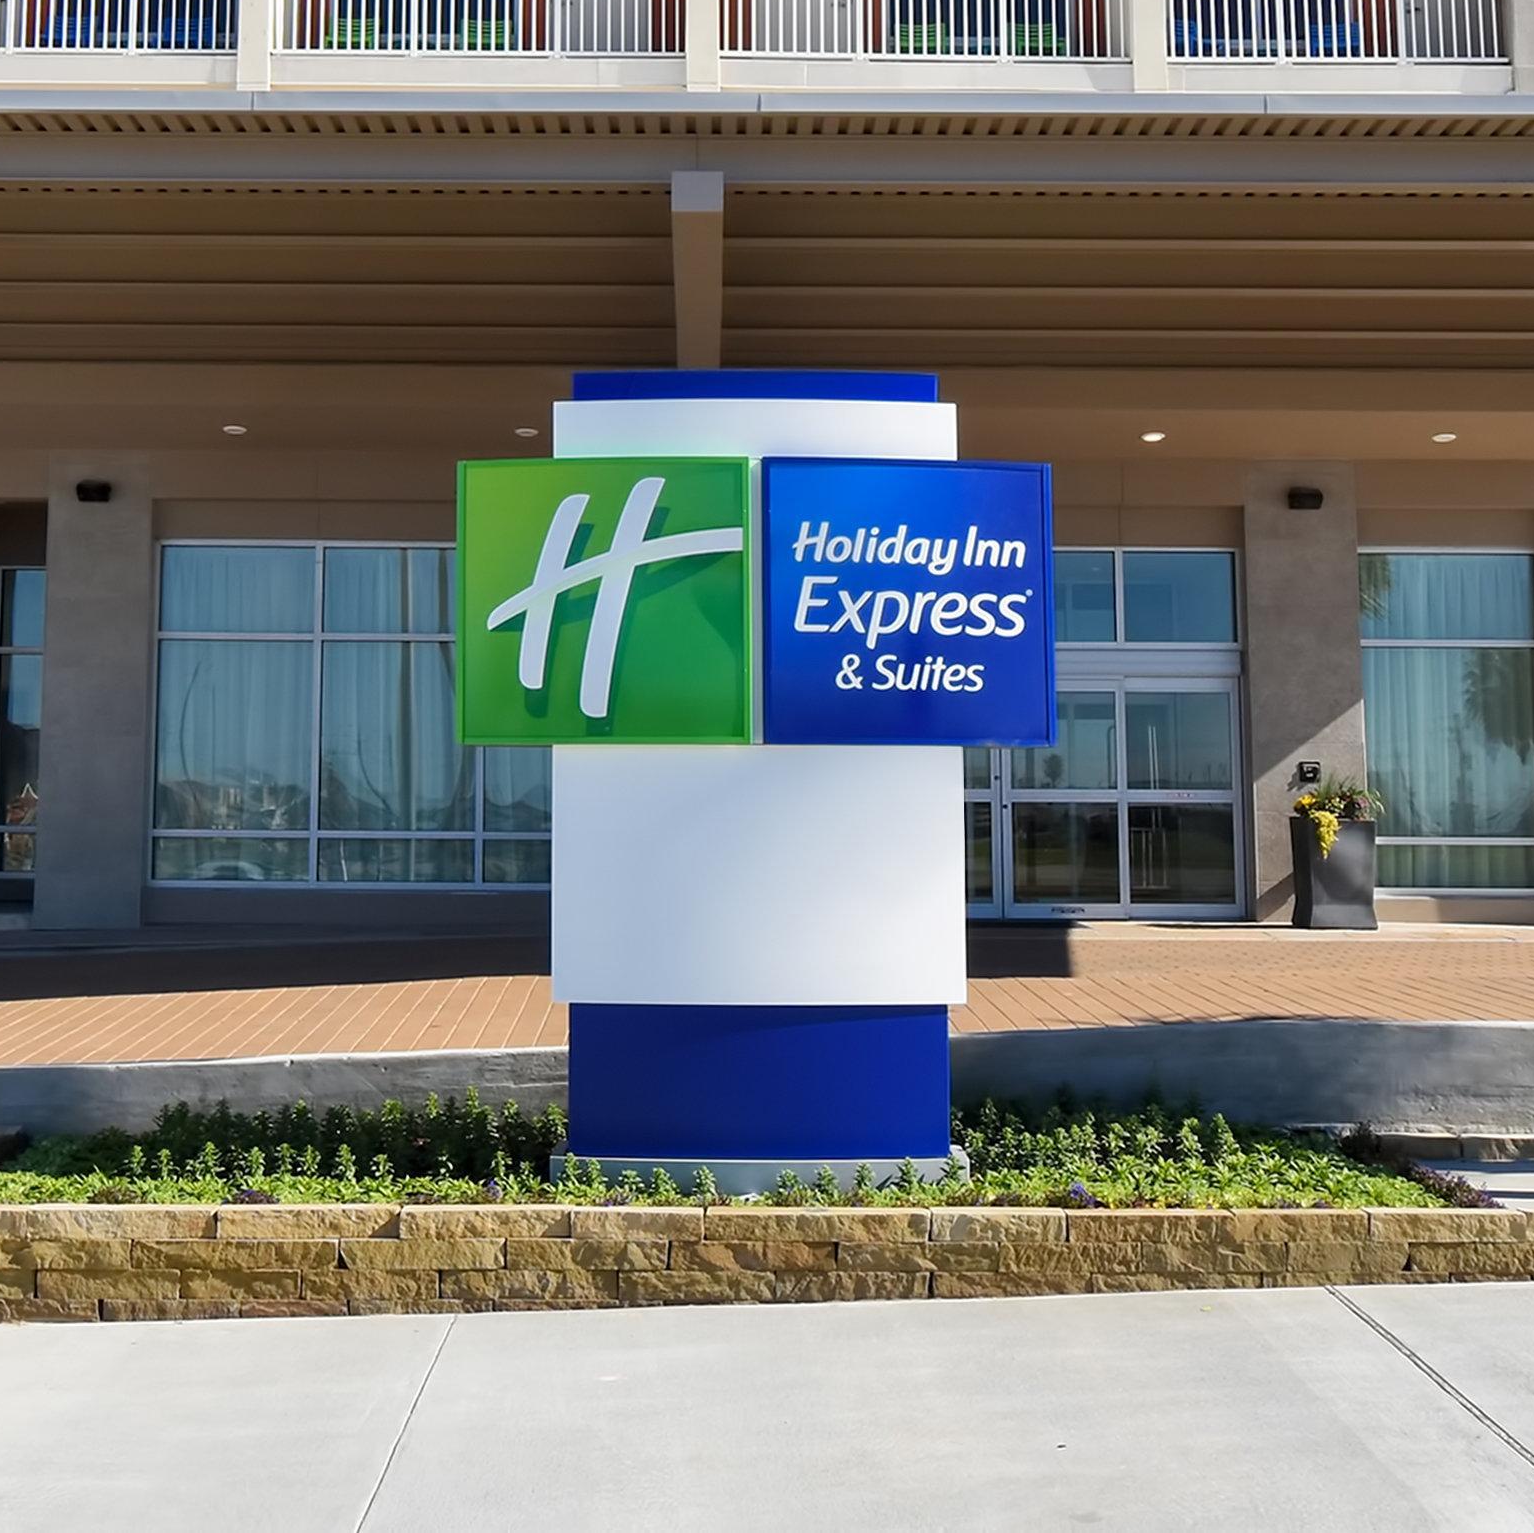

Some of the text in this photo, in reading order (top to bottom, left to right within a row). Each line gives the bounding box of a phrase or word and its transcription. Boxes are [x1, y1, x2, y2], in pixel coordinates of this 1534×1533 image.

[792, 521, 1027, 576] Holiday Inn
[793, 574, 1028, 650] Express
[835, 653, 985, 693] & Suites
